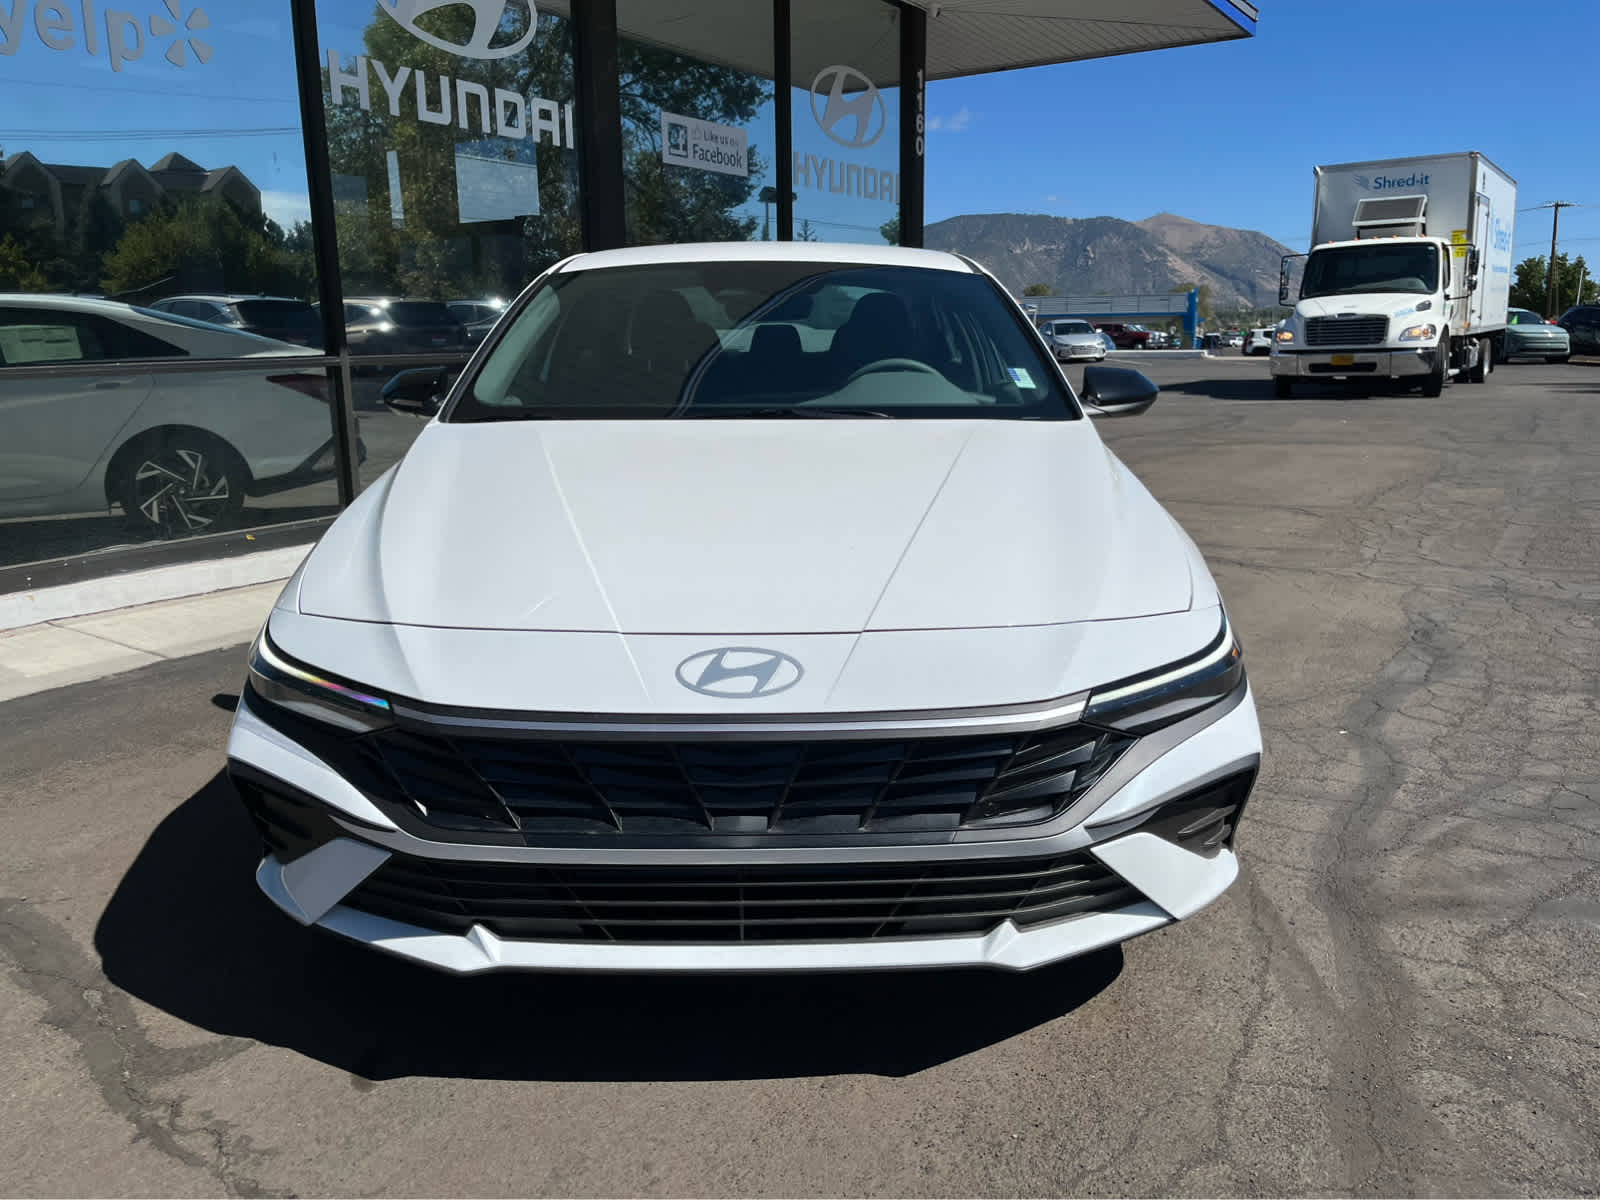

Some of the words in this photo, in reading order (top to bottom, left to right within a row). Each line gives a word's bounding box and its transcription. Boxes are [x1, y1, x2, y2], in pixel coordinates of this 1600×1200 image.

[327, 50, 575, 149] HYUNDAI
[915, 68, 924, 156] 1160
[692, 143, 742, 168] Facebook
[1373, 173, 1430, 190] Shred-it
